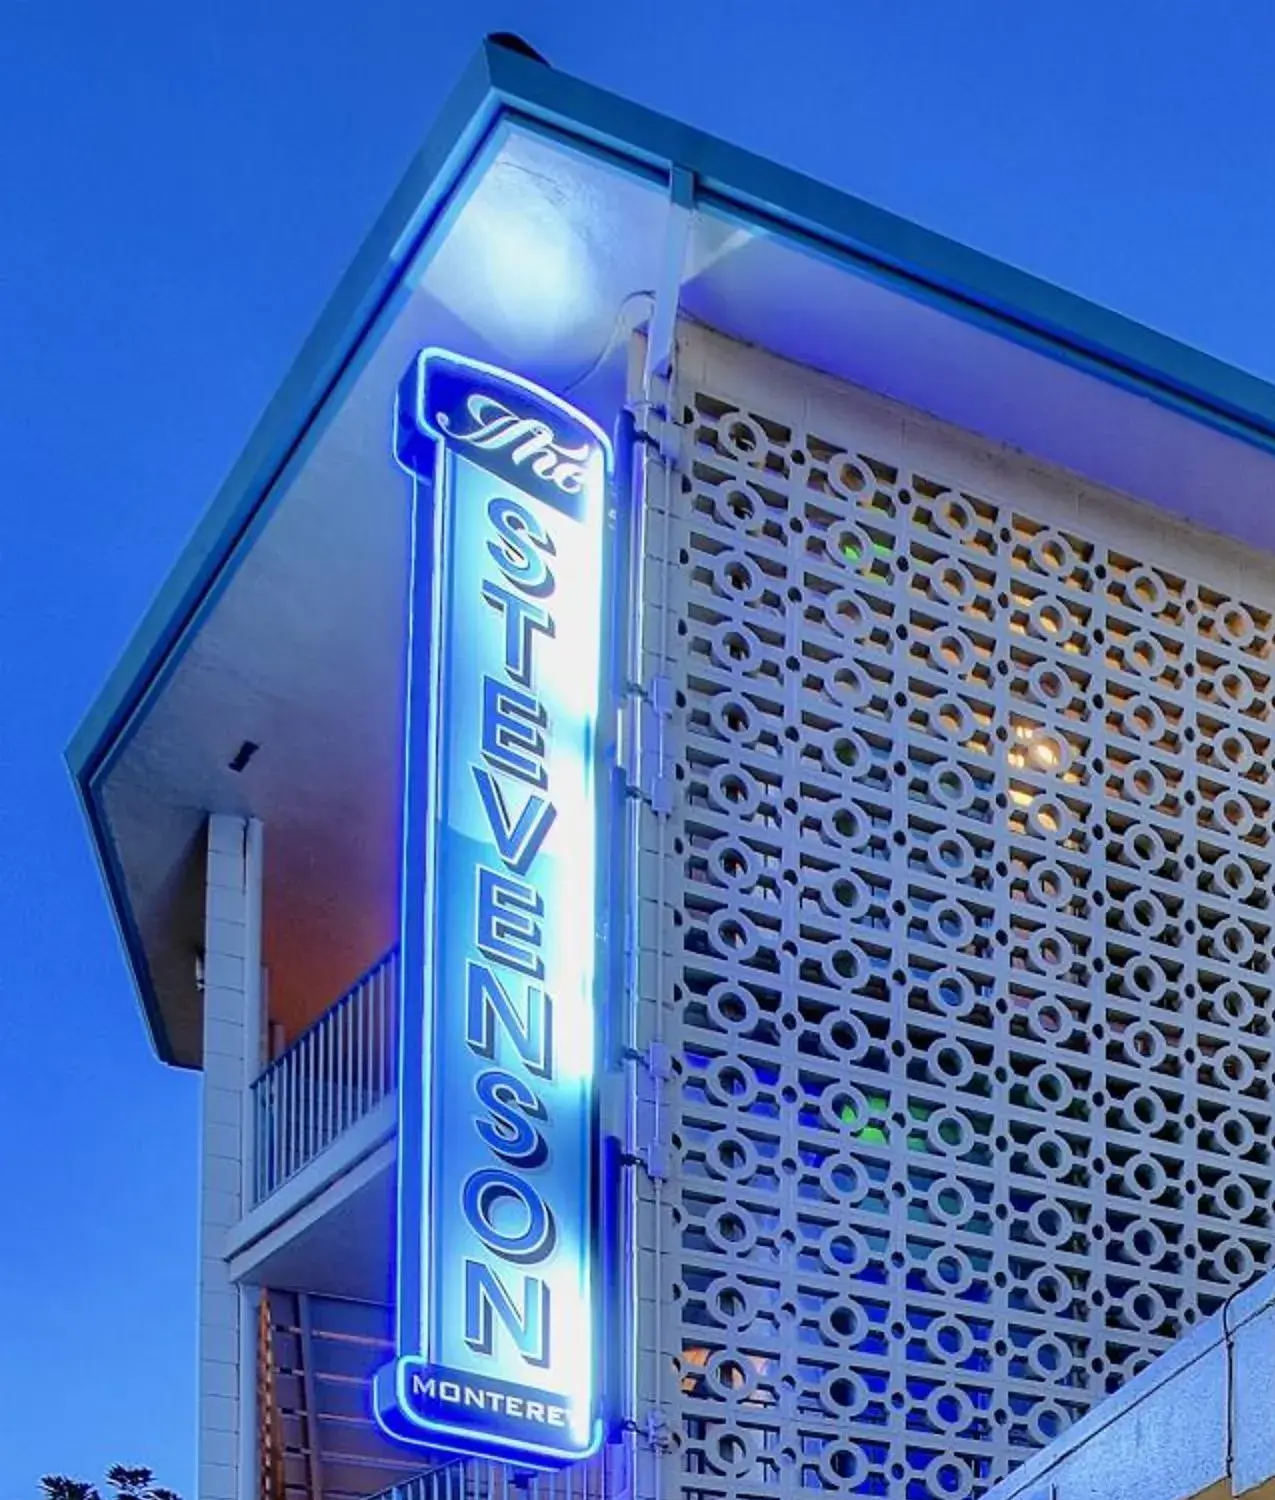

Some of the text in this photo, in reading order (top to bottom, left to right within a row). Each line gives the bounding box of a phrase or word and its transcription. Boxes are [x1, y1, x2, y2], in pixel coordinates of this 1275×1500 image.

[435, 394, 592, 494] The
[460, 496, 558, 1371] STEVENSON
[412, 1374, 576, 1428] MONTERE
